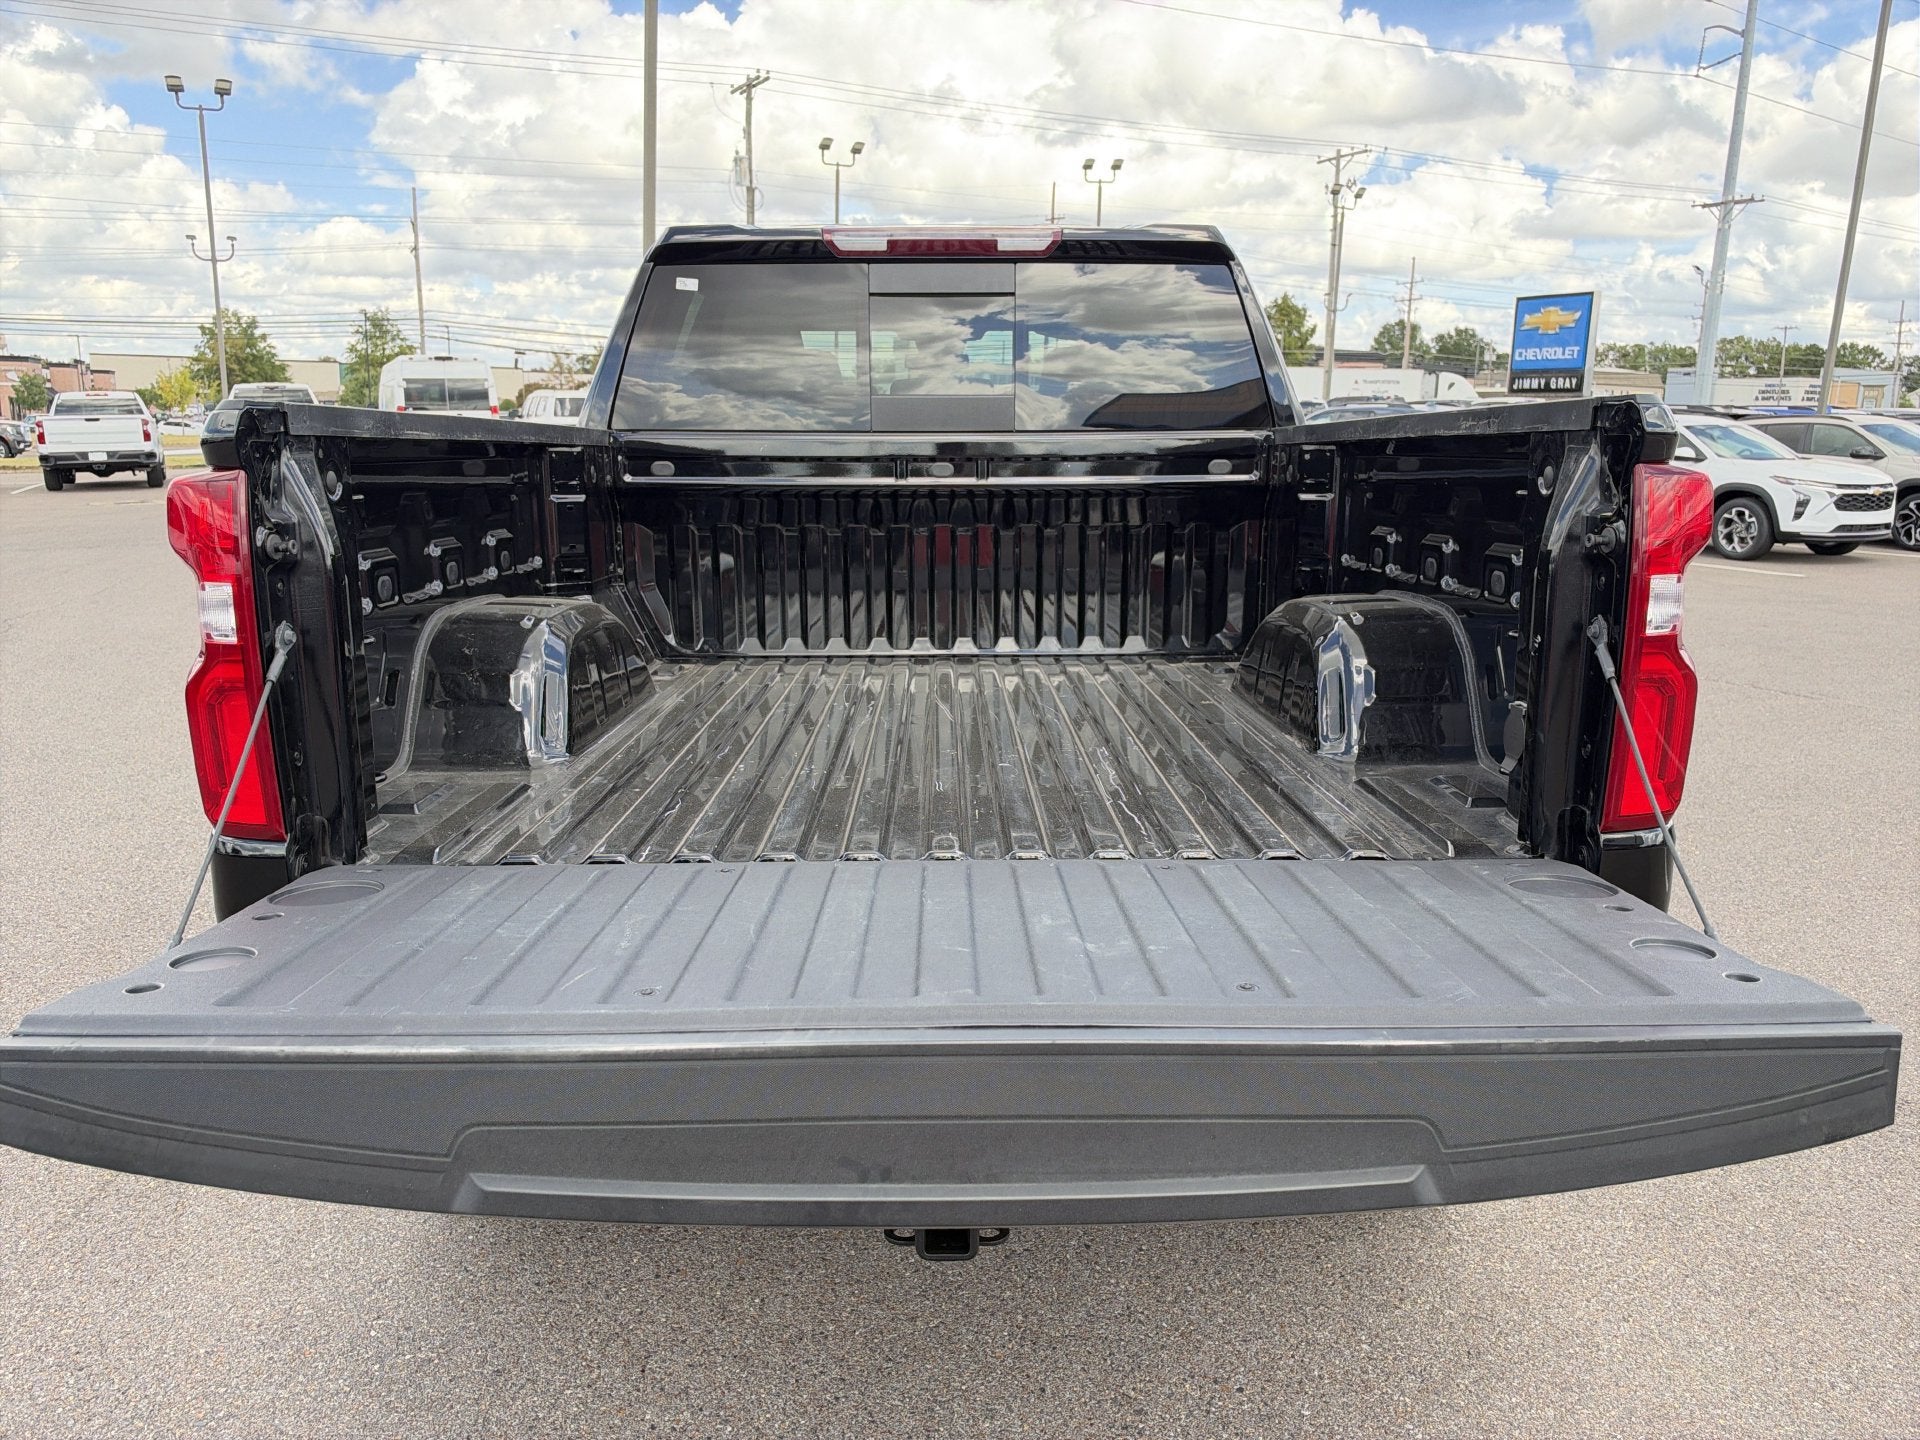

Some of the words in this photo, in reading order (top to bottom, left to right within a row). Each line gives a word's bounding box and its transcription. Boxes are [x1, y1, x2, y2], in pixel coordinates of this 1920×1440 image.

[1515, 346, 1580, 361] CHEVROLET
[1512, 377, 1546, 390] JIMMY
[1550, 377, 1578, 389] GRAY
